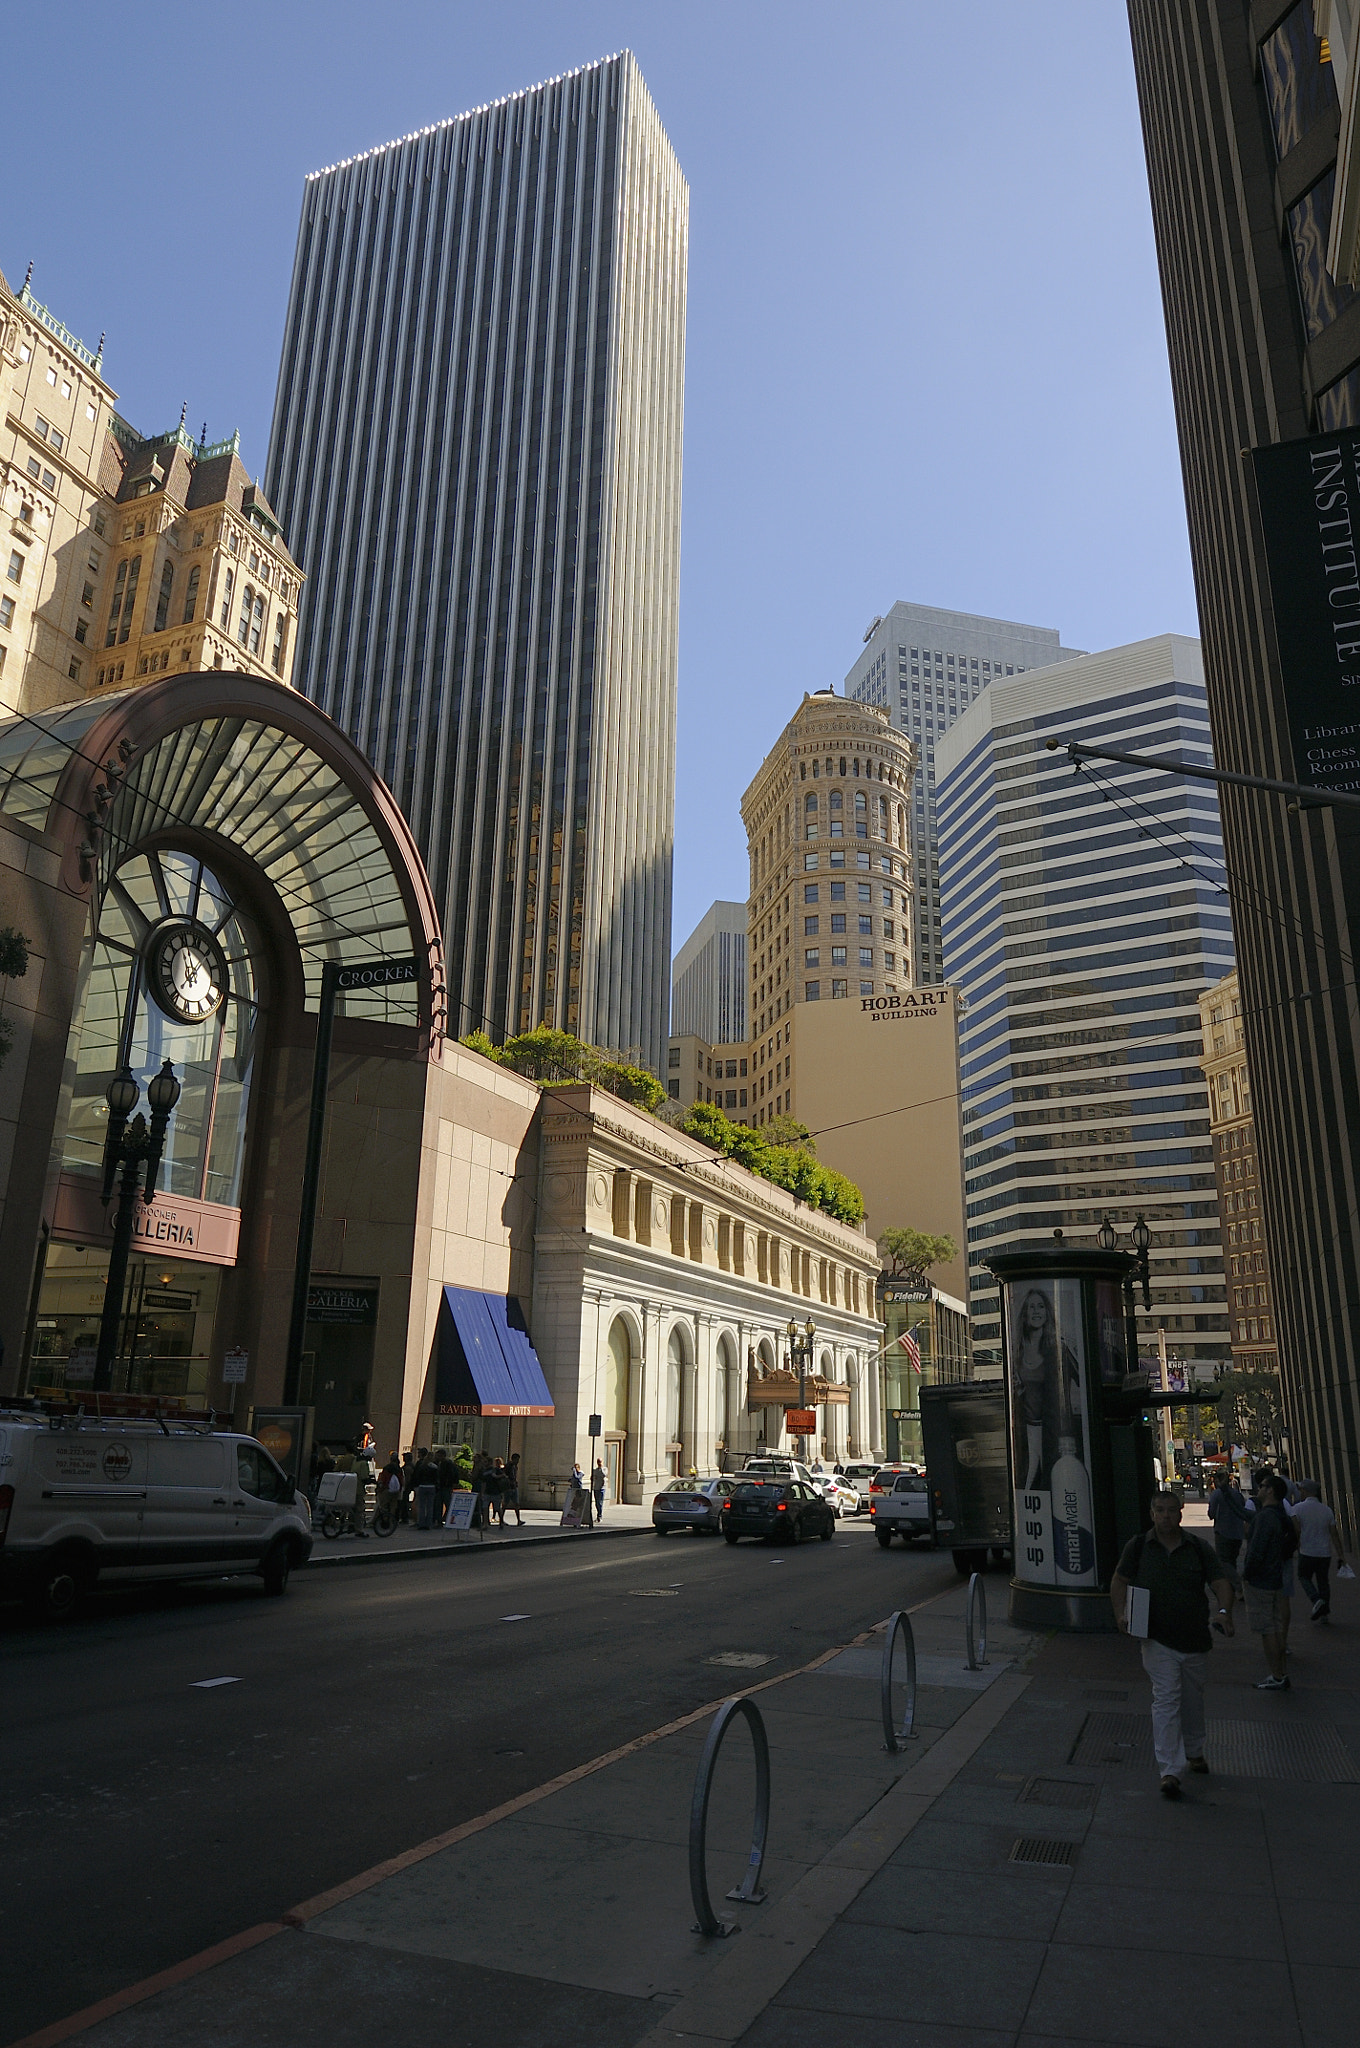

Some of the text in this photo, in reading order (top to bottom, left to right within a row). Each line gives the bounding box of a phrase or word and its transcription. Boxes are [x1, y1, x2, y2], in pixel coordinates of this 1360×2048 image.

[1304, 724, 1360, 740] Librar
[1307, 747, 1357, 761] Chess
[338, 965, 414, 986] CROCKER
[860, 991, 948, 1011] HOBART
[871, 1008, 938, 1021] BUILDING
[307, 1293, 369, 1309] GALLERIA
[894, 1291, 929, 1301] Fidelity
[958, 1447, 978, 1464] ups
[1024, 1495, 1041, 1514] up
[1026, 1521, 1043, 1540] up
[1063, 1488, 1082, 1573] smartwater
[1027, 1547, 1044, 1566] up
